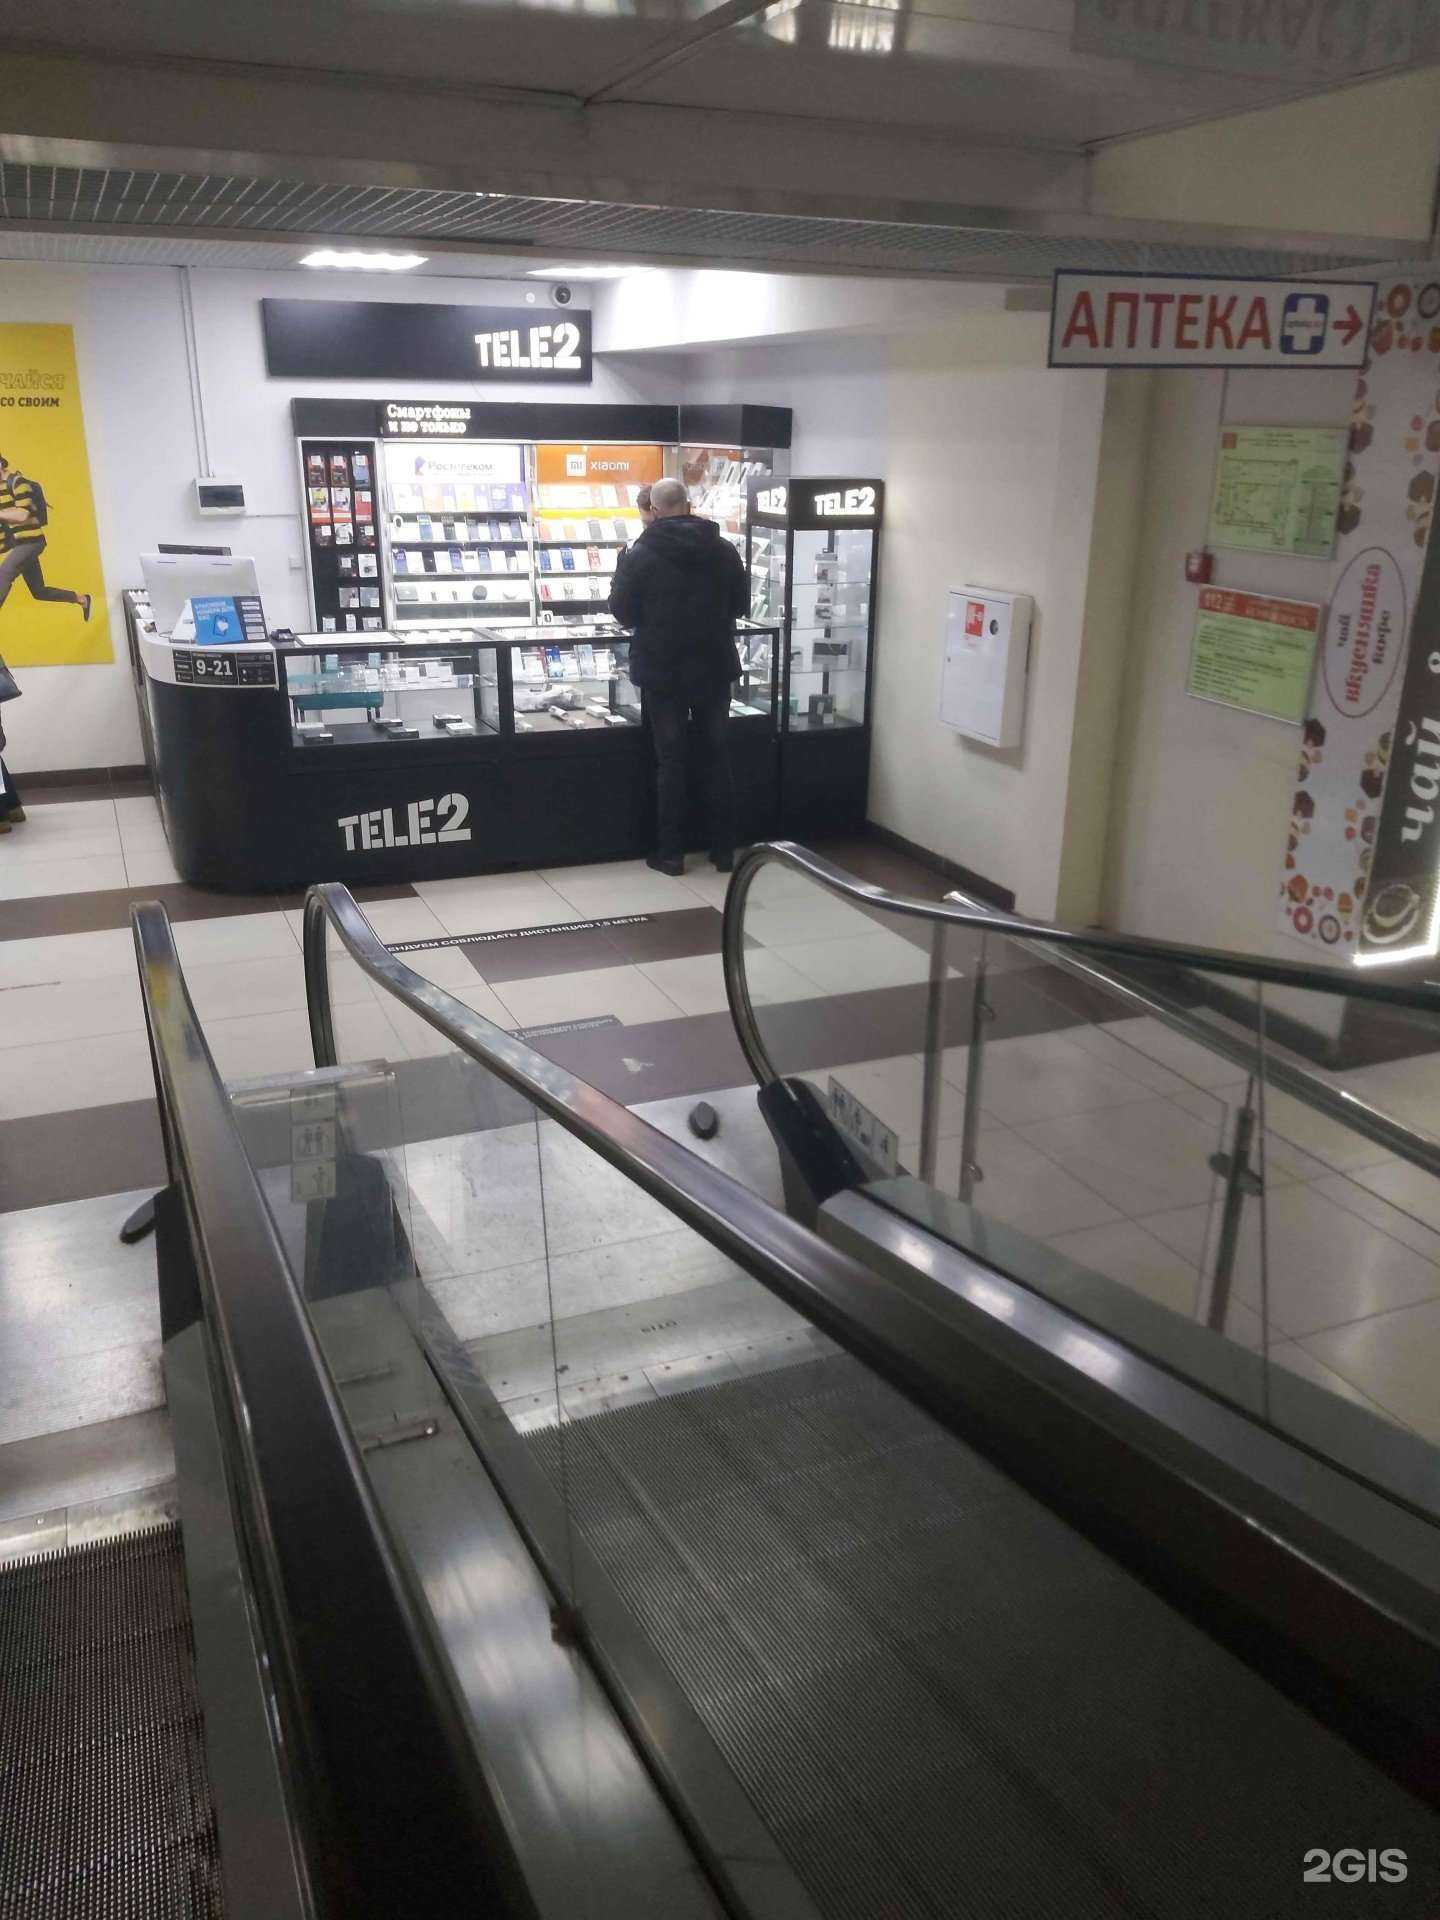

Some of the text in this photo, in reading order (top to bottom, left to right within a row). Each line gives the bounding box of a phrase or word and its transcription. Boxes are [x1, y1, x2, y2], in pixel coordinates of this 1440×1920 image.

[1061, 290, 1272, 350] АПТЕКА
[474, 322, 582, 369] TELE2
[18, 396, 60, 408] СВОИМ
[386, 403, 471, 421] Смартфоны
[420, 421, 467, 434] только
[814, 486, 875, 516] TELE2
[196, 659, 233, 676] 9-21
[1401, 716, 1440, 842] чай
[337, 792, 472, 851] TELE2
[440, 932, 518, 946] СОБЛЮДАТЬ
[519, 922, 594, 937] ДИСТАНЦИЮ
